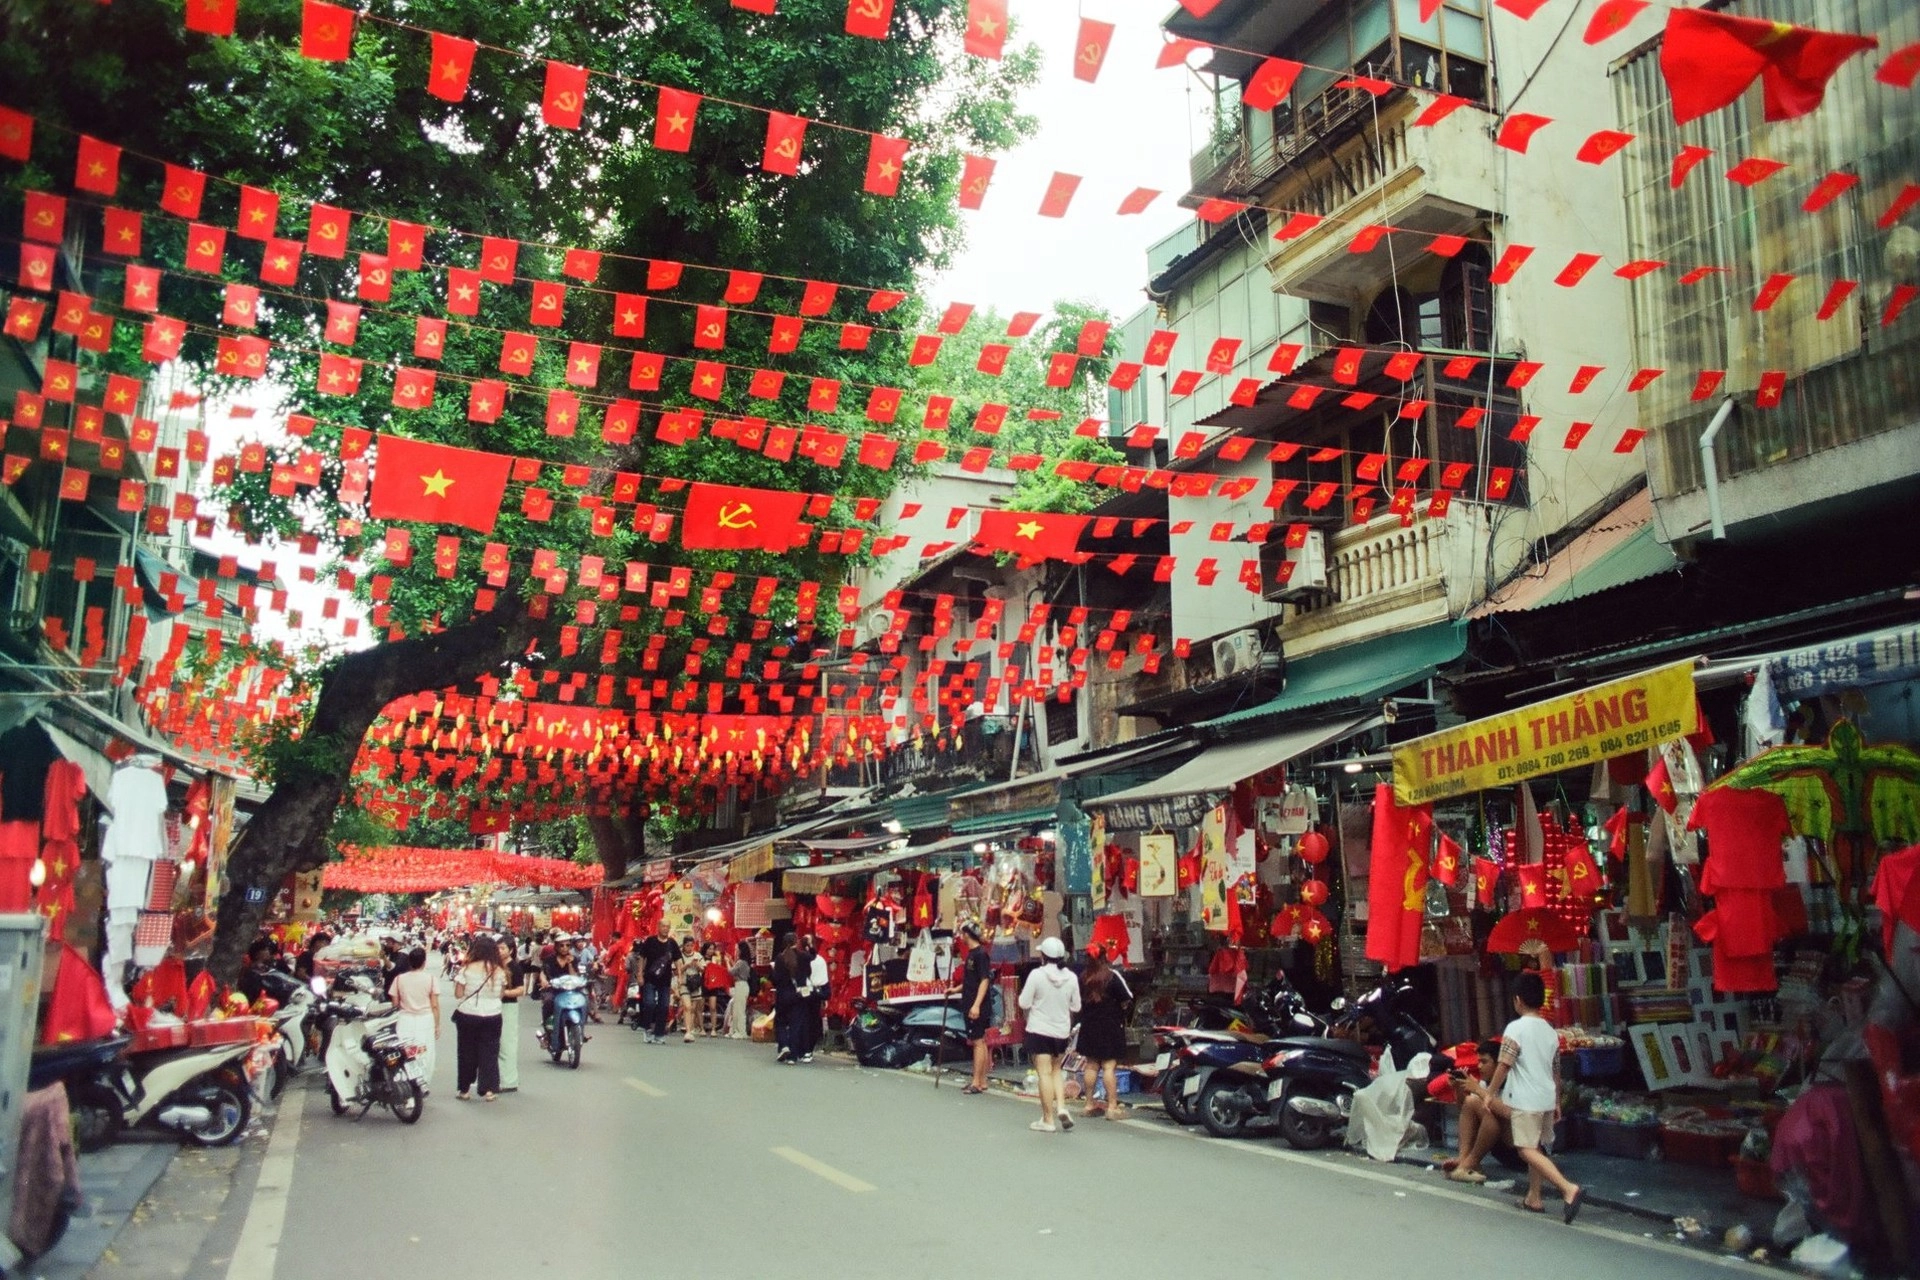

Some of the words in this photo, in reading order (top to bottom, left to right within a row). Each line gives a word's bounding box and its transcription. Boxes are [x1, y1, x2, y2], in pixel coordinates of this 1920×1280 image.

[1421, 726, 1520, 780] THANH
[1528, 688, 1649, 751] THẮNG
[1517, 758, 1541, 775] 0984
[1543, 752, 1565, 768] 780
[1568, 745, 1591, 762] 269
[1108, 802, 1147, 828] HÀNG
[250, 889, 262, 900] 19
